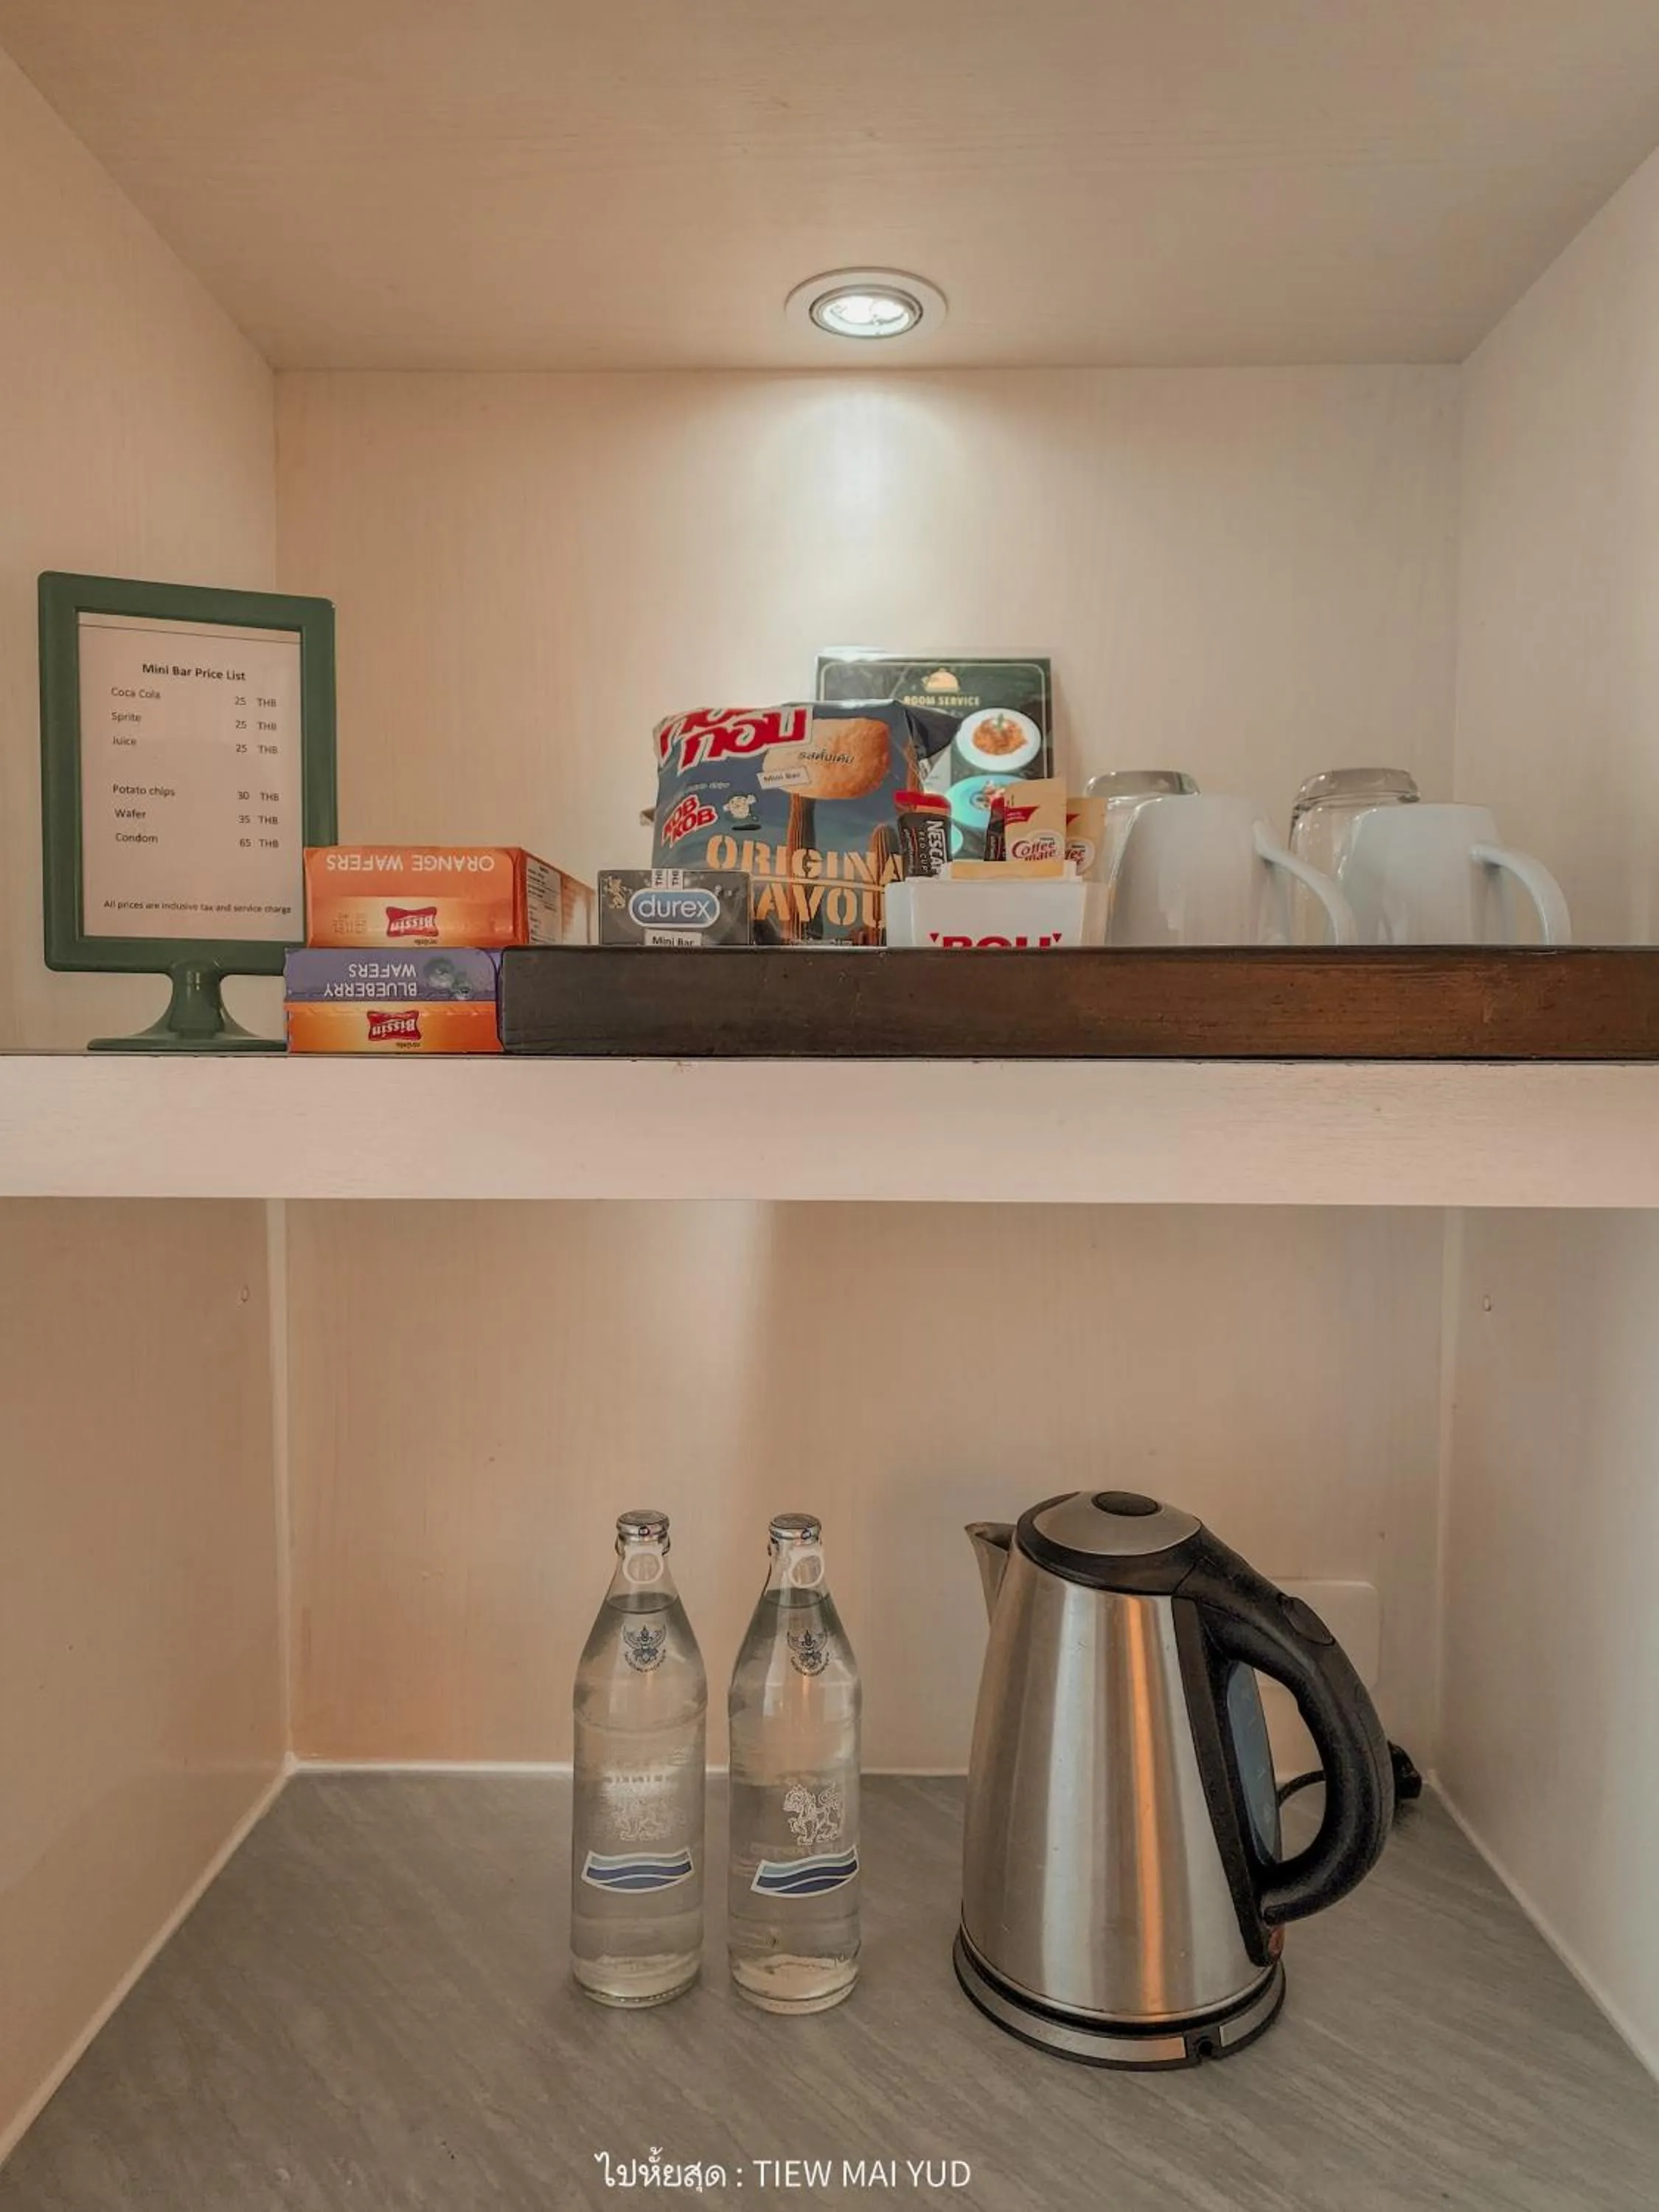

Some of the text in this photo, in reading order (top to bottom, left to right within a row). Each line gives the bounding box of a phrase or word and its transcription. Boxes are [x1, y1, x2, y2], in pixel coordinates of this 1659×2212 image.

[142, 664, 246, 681] Mini Bar Price List
[111, 687, 161, 700] Coca Cola
[234, 696, 277, 707] 25 THB
[903, 695, 980, 706] ROOM SERVICE
[111, 712, 142, 723] Sprite
[235, 720, 277, 731] 25 THB
[112, 736, 137, 745] Juice
[236, 744, 278, 754] 25 THB
[112, 784, 175, 798] Potato chips
[237, 791, 279, 801] 30 THB
[114, 808, 147, 819] Wafer
[239, 815, 279, 825] 35 THB
[115, 832, 159, 844] Condom
[240, 838, 279, 848] 65 THB
[926, 820, 947, 873] NESCAF
[326, 855, 495, 872] ORANGE WAFERS
[706, 834, 905, 883] ORIGINA
[104, 900, 116, 908] All
[117, 901, 143, 911] prices
[161, 902, 198, 911] inclusive
[215, 904, 232, 912] and
[233, 905, 262, 913] service
[264, 906, 291, 915] charge
[638, 894, 712, 921] durex
[653, 936, 694, 946] Mini Bar
[348, 963, 417, 978] WAFERS
[324, 982, 417, 996] BLUEBERRY
[371, 1019, 415, 1037] Bissin
